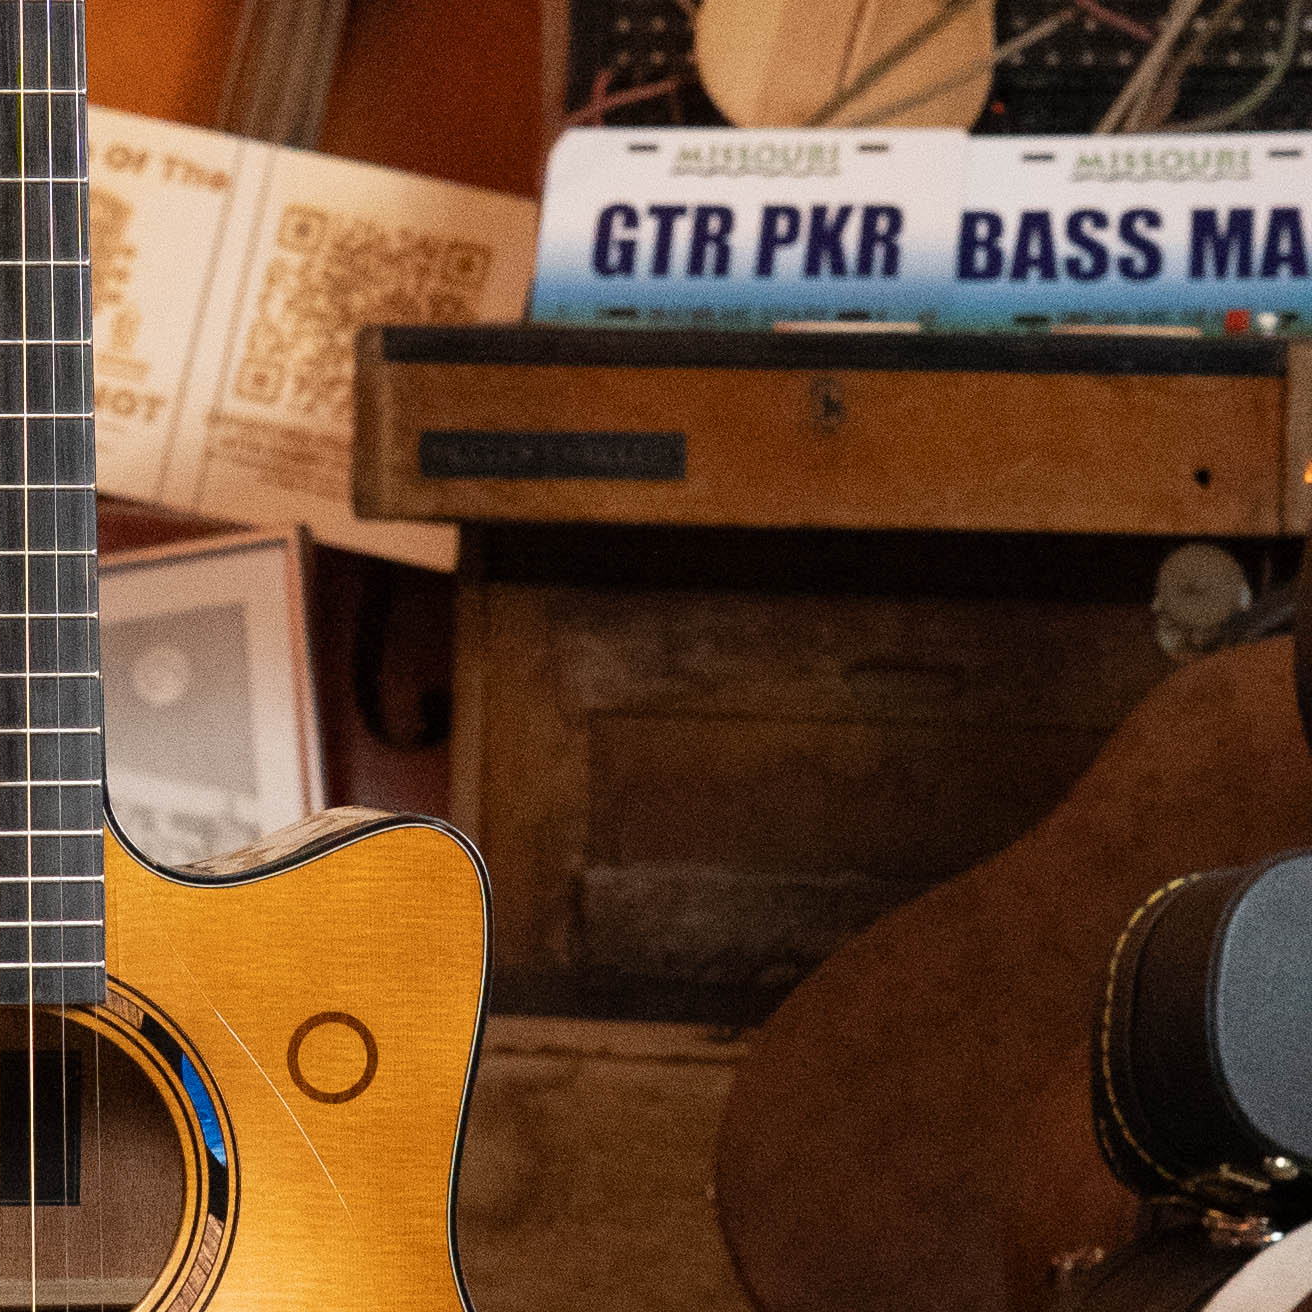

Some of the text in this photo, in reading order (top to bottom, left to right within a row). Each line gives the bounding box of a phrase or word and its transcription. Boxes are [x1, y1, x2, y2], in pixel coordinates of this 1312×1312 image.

[672, 142, 840, 172] MISSOURI
[1071, 148, 1253, 177] MISSOURI
[593, 202, 906, 279] GTR PKR
[957, 207, 1310, 283] BASS MA
